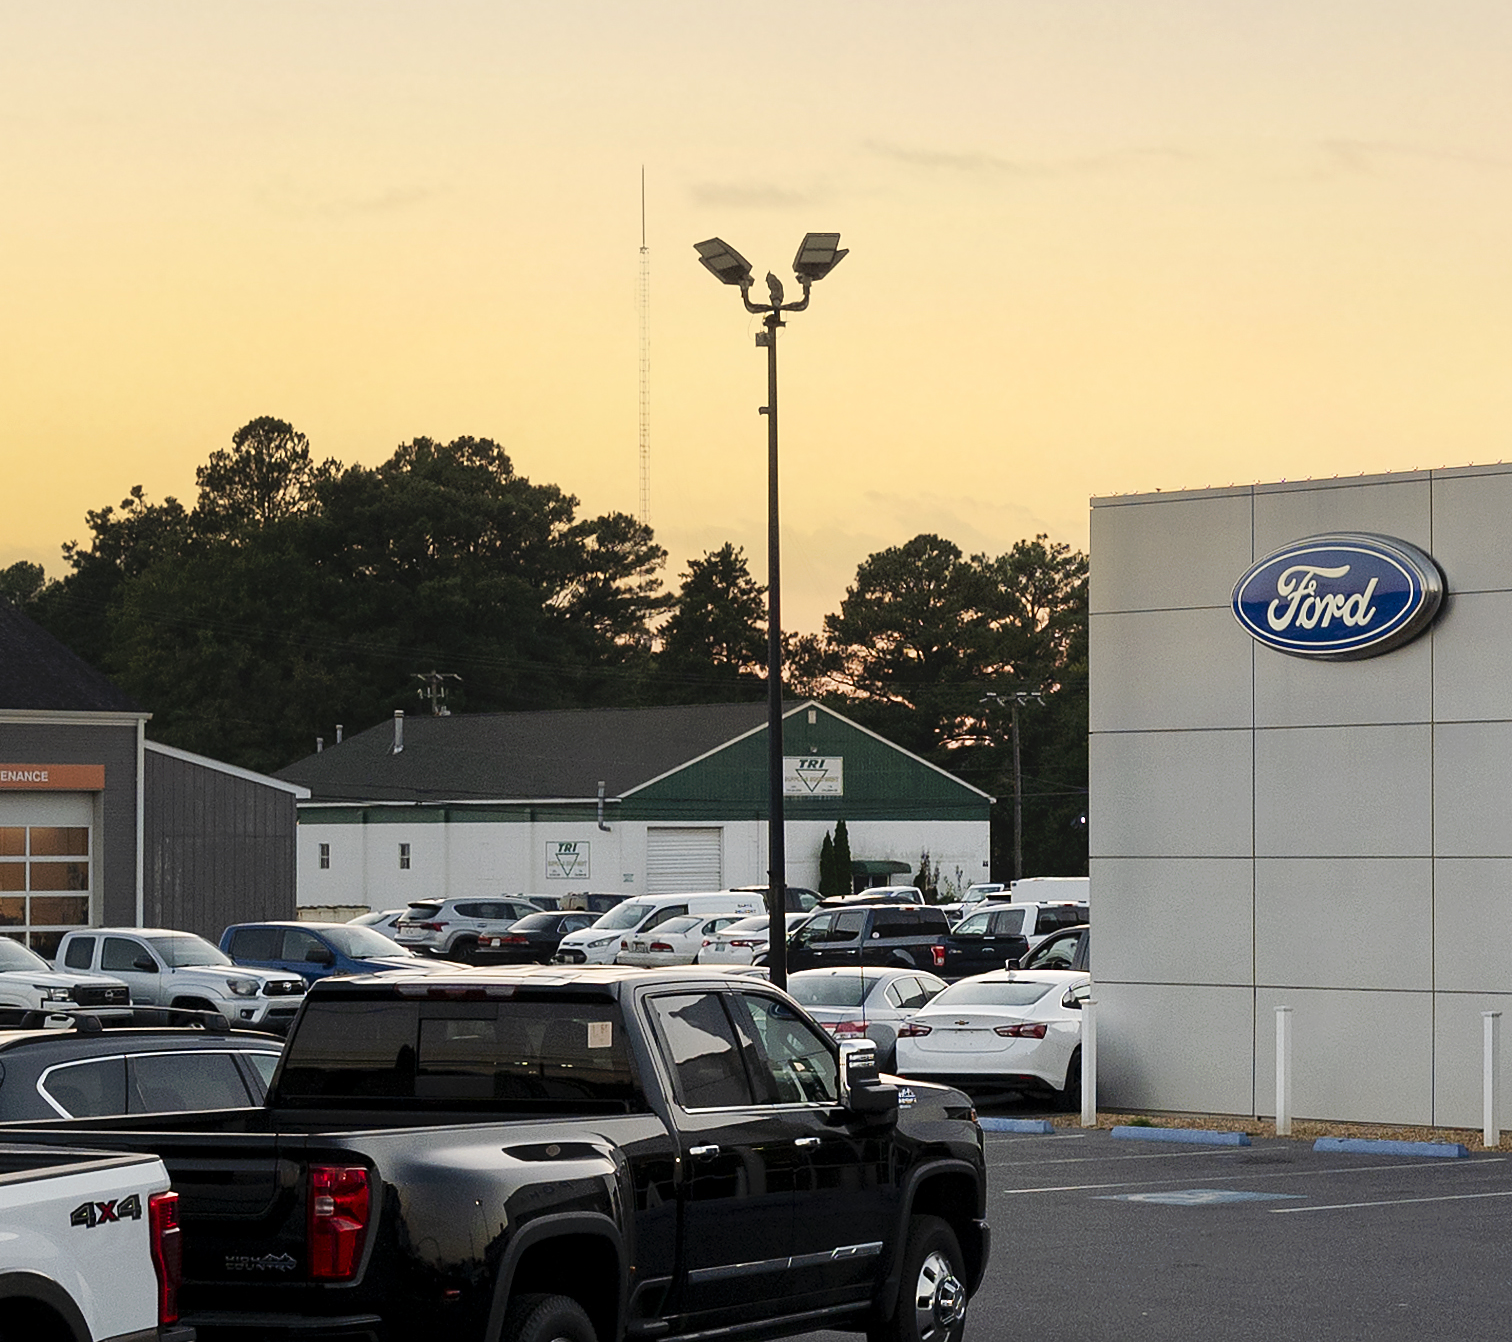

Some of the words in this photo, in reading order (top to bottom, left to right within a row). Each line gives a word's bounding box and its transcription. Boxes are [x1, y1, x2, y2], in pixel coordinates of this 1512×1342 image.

[1266, 563, 1378, 631] Ford
[799, 759, 826, 769] TRI
[558, 842, 578, 853] TRI
[225, 1255, 261, 1263] HIGH
